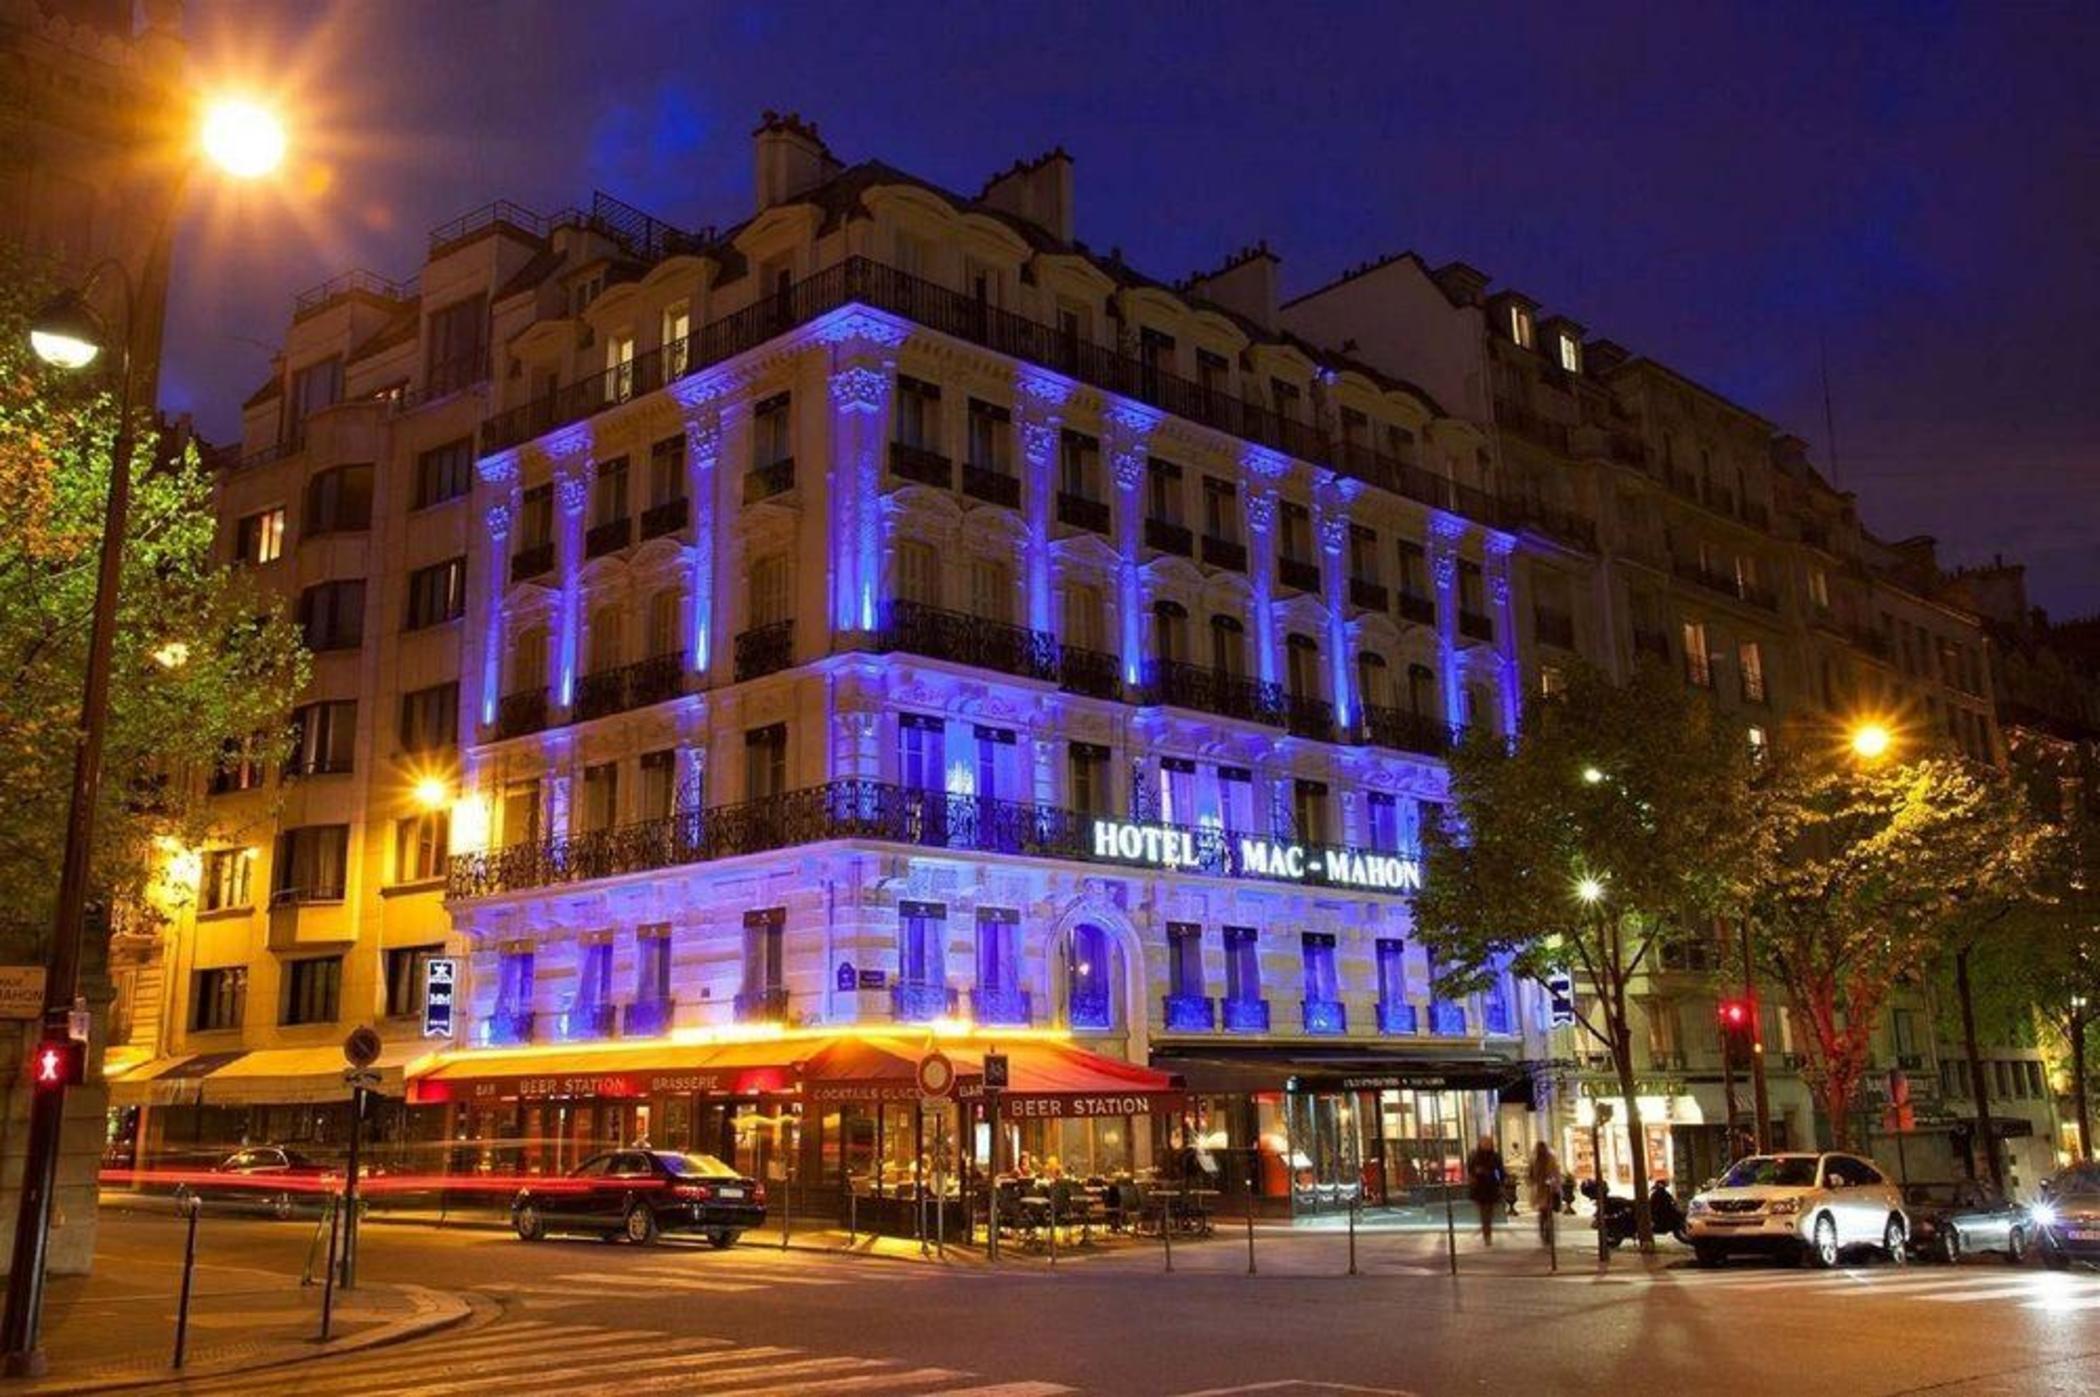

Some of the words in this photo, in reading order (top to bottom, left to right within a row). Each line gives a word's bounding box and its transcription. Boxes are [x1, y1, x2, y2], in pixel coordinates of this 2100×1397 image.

[1094, 820, 1199, 866] HOTEL
[476, 1083, 496, 1096] BAR
[520, 1079, 557, 1094] BEER
[564, 1076, 625, 1093] STATION
[653, 1076, 718, 1091] BRASSERIE
[1011, 1099, 1062, 1117] BEER
[1073, 1096, 1149, 1115] STATION
